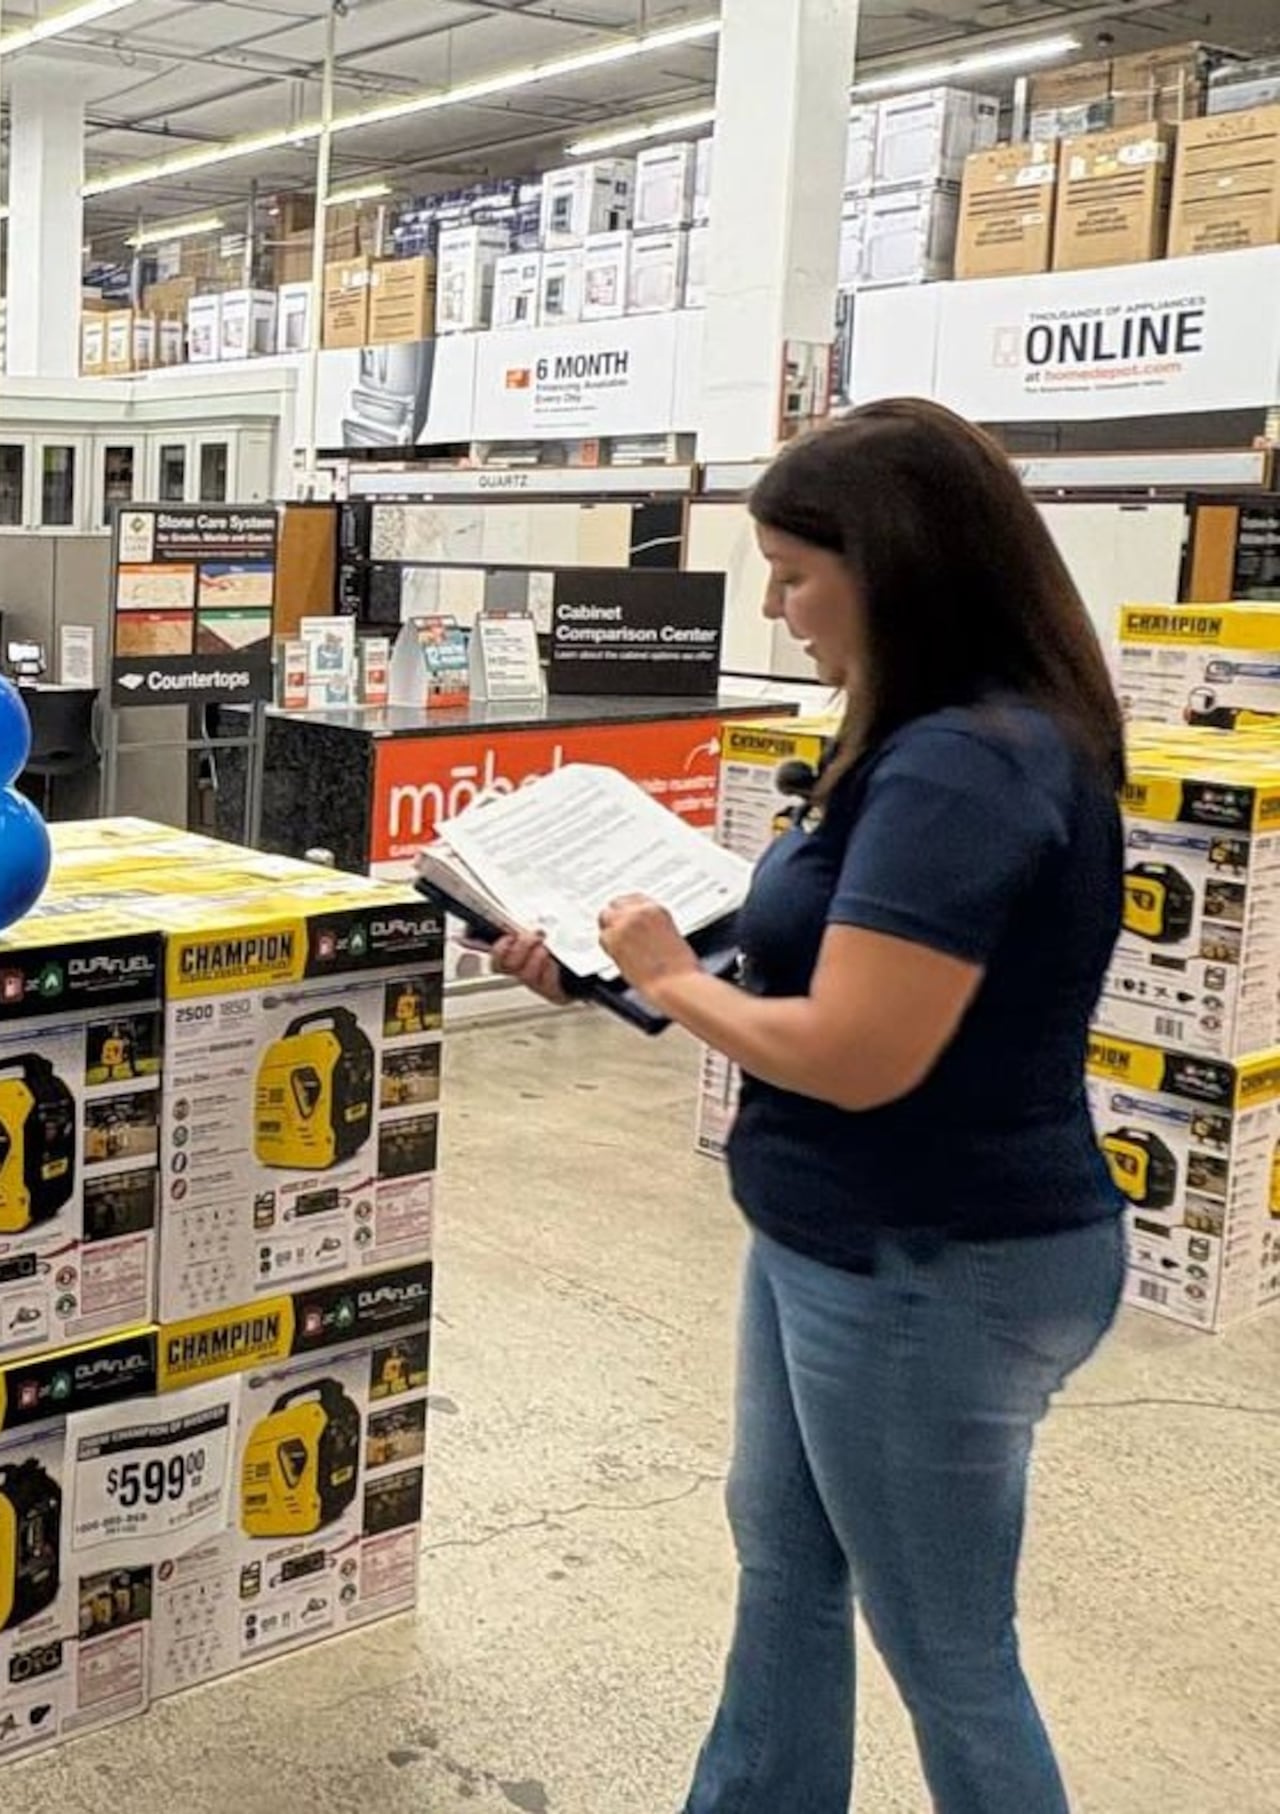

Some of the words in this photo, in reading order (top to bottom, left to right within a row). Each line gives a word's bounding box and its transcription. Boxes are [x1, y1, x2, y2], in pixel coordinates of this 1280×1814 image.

[1126, 296, 1206, 313] APPLIANCES
[1026, 309, 1205, 365] ONLINE
[536, 359, 548, 380] 6
[554, 350, 629, 379] MONTH
[1025, 371, 1040, 383] at
[1045, 361, 1182, 382] homedepot.com
[479, 474, 528, 489] QUARTZ
[197, 514, 228, 529] Care
[229, 514, 275, 532] System
[556, 604, 623, 621] Cabinet
[556, 625, 658, 644] Comparison
[660, 625, 718, 643] Center
[1127, 614, 1222, 636] CHAMPION
[147, 671, 250, 691] Countertops
[388, 745, 564, 837] mōb
[180, 932, 292, 974] CHAMPION
[176, 1003, 213, 1023] 2500
[1091, 1043, 1131, 1067] PION
[168, 1314, 281, 1365] CHAMPION
